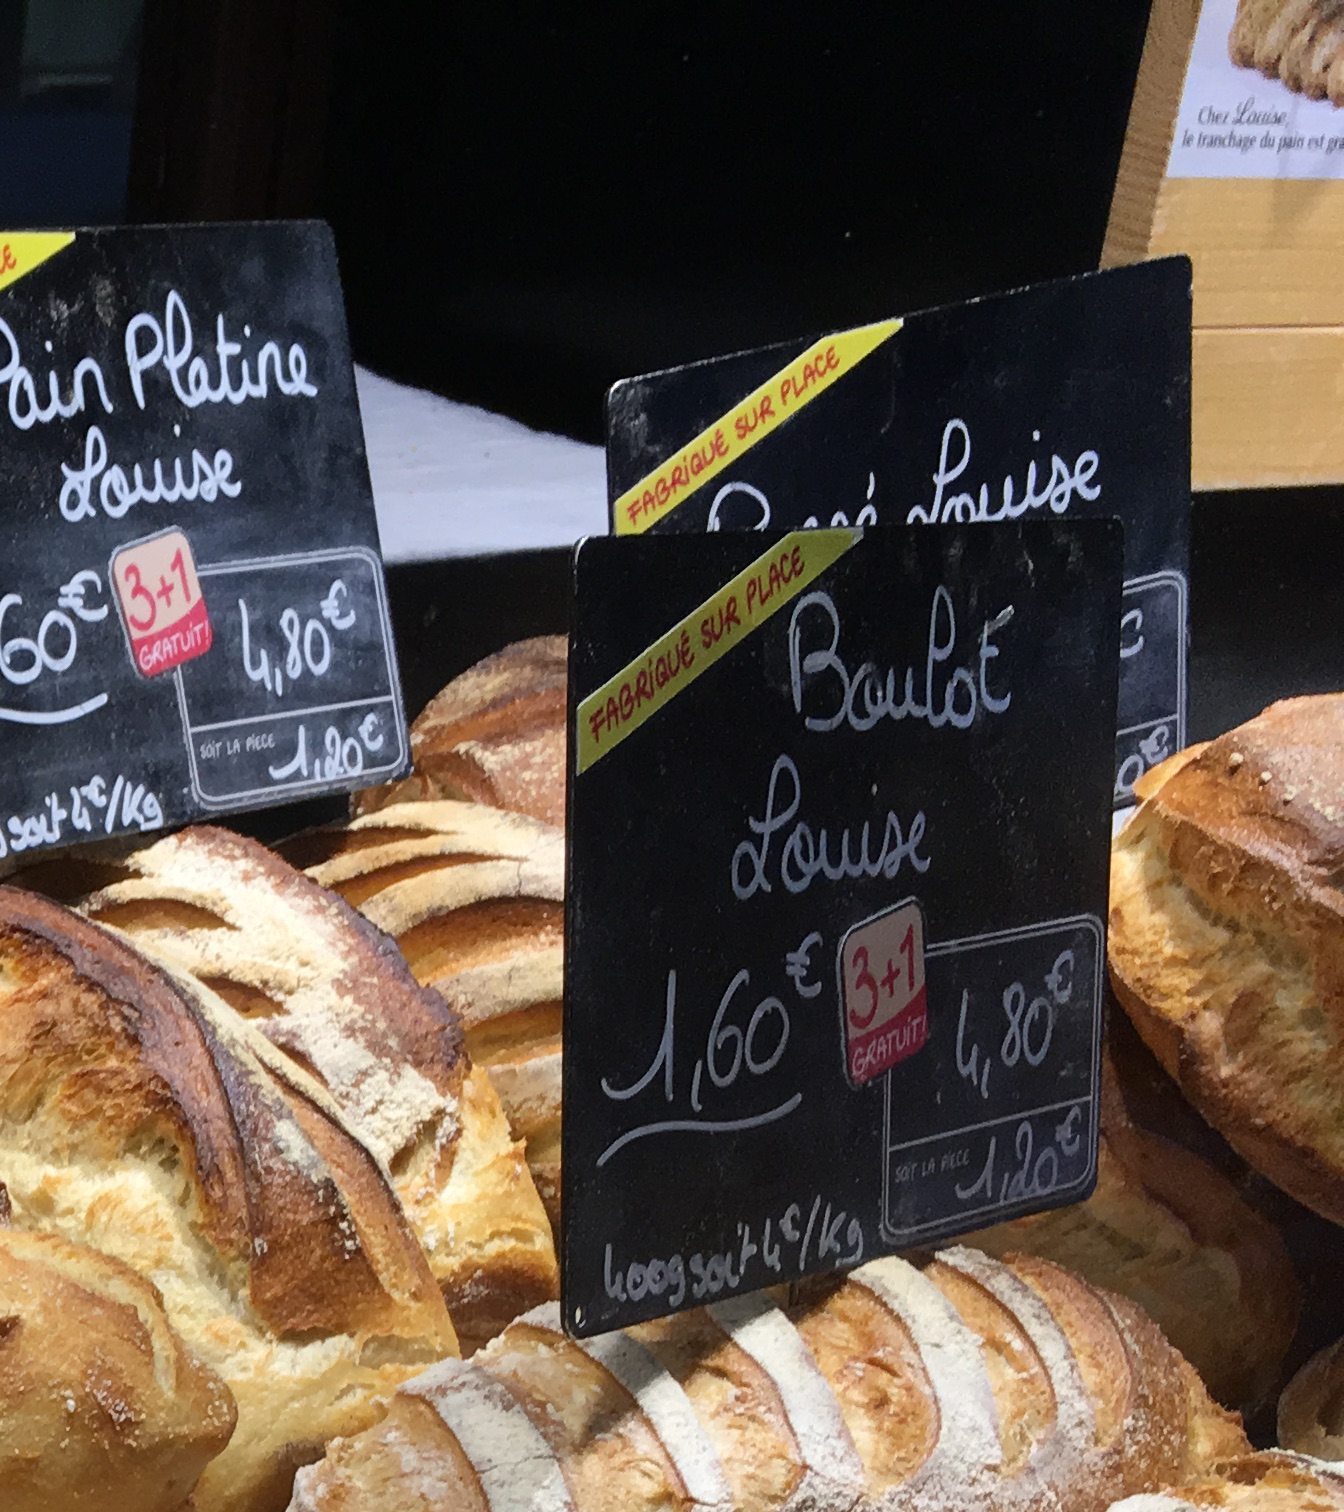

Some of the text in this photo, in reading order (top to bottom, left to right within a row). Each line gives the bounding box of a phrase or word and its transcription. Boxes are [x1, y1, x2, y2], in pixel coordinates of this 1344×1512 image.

[1259, 130, 1276, 149] du
[1276, 130, 1306, 156] pain
[125, 289, 318, 410] Platine
[58, 424, 242, 523] Louise
[626, 428, 729, 526] FABRIQUÉ
[734, 394, 775, 440] SUR
[779, 345, 841, 406] PLACE
[906, 417, 1102, 524] Louise
[120, 548, 195, 633] 3+1
[237, 579, 356, 698] 4,80€
[136, 621, 212, 674] GRATUIT!
[588, 545, 806, 744] FABRIQUÉ SUR PLACE
[200, 740, 222, 760] SOIT
[226, 738, 241, 756] LA
[730, 753, 932, 899] Louise
[600, 932, 824, 1113] 1,60€
[847, 923, 915, 1030] 3+1
[953, 949, 1075, 1099] 4,80€
[851, 1013, 929, 1078] GRATUIT!
